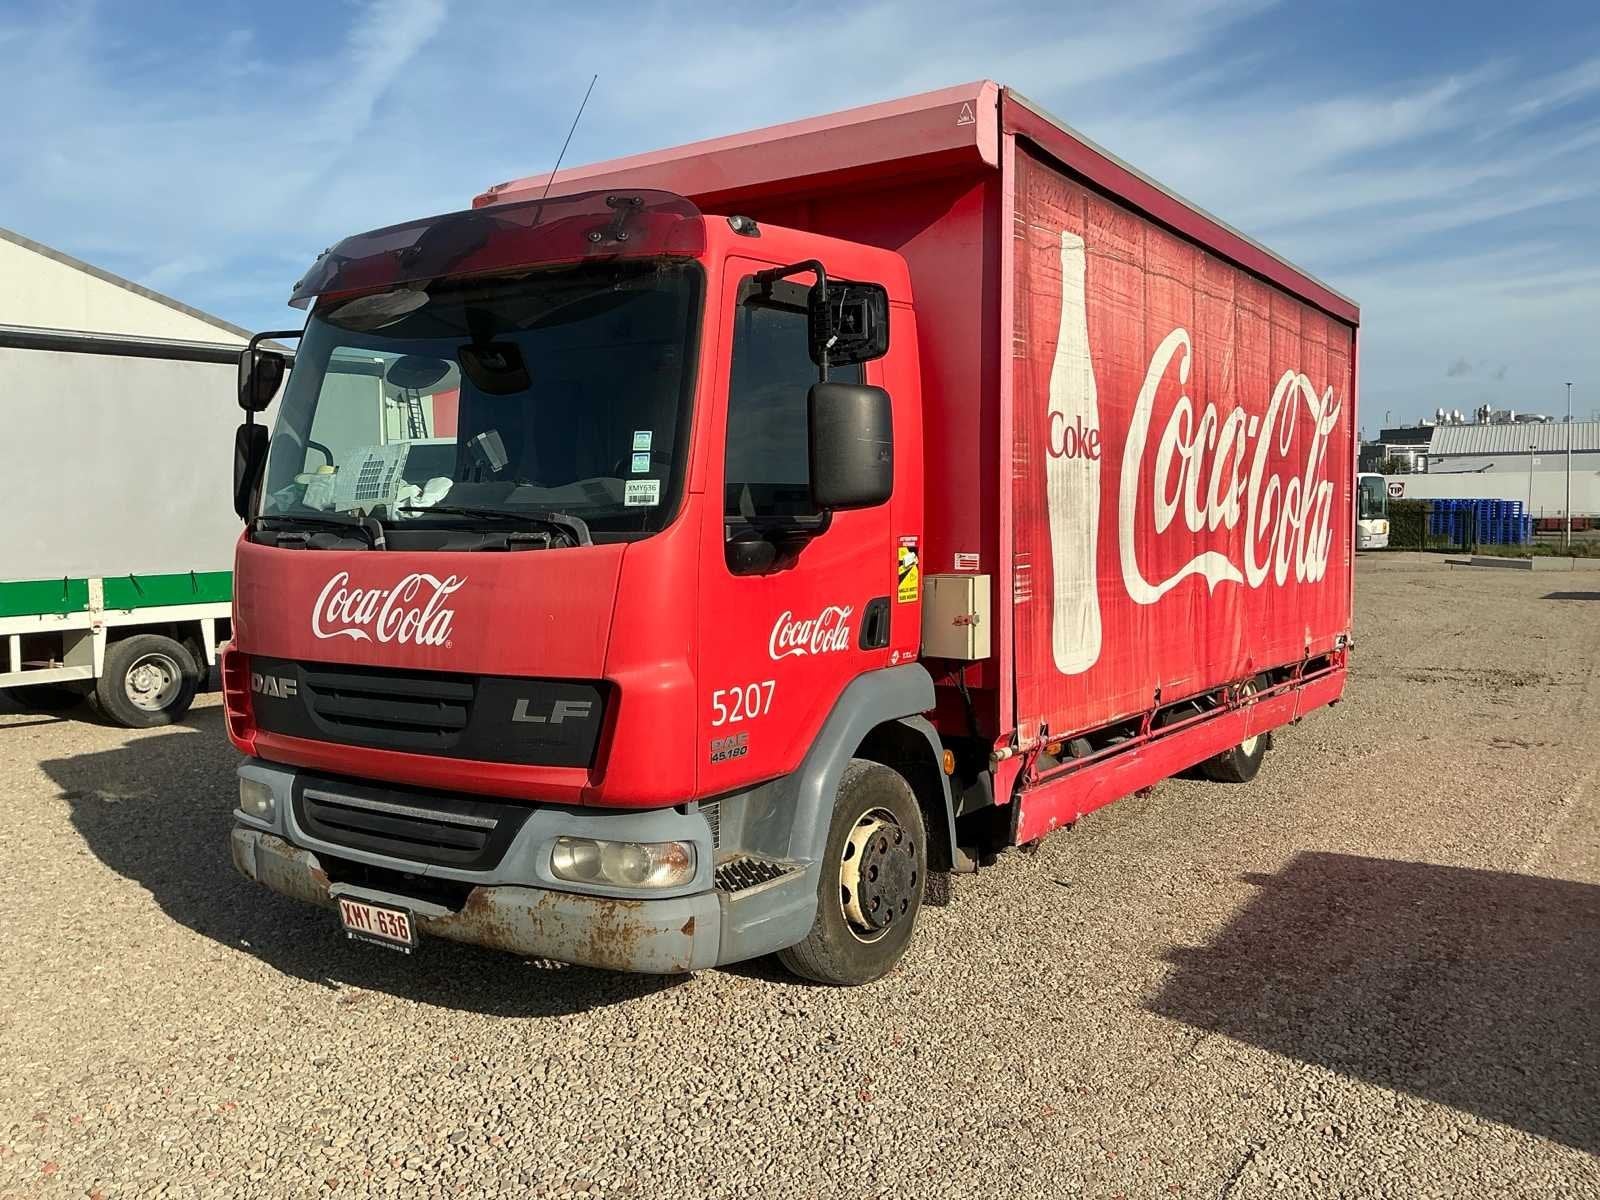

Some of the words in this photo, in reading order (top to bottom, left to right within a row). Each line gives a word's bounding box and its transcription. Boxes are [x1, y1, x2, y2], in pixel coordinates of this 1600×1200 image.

[1047, 410, 1101, 461] Coke
[628, 484, 657, 492] XMY636
[1119, 327, 1342, 605] Coca-Cola
[1389, 486, 1403, 495] TIP
[312, 571, 468, 647] Coca-Cola
[768, 605, 854, 661] Coca-Cola
[251, 672, 297, 699] DAF
[711, 680, 776, 727] 5207
[511, 699, 593, 724] LF
